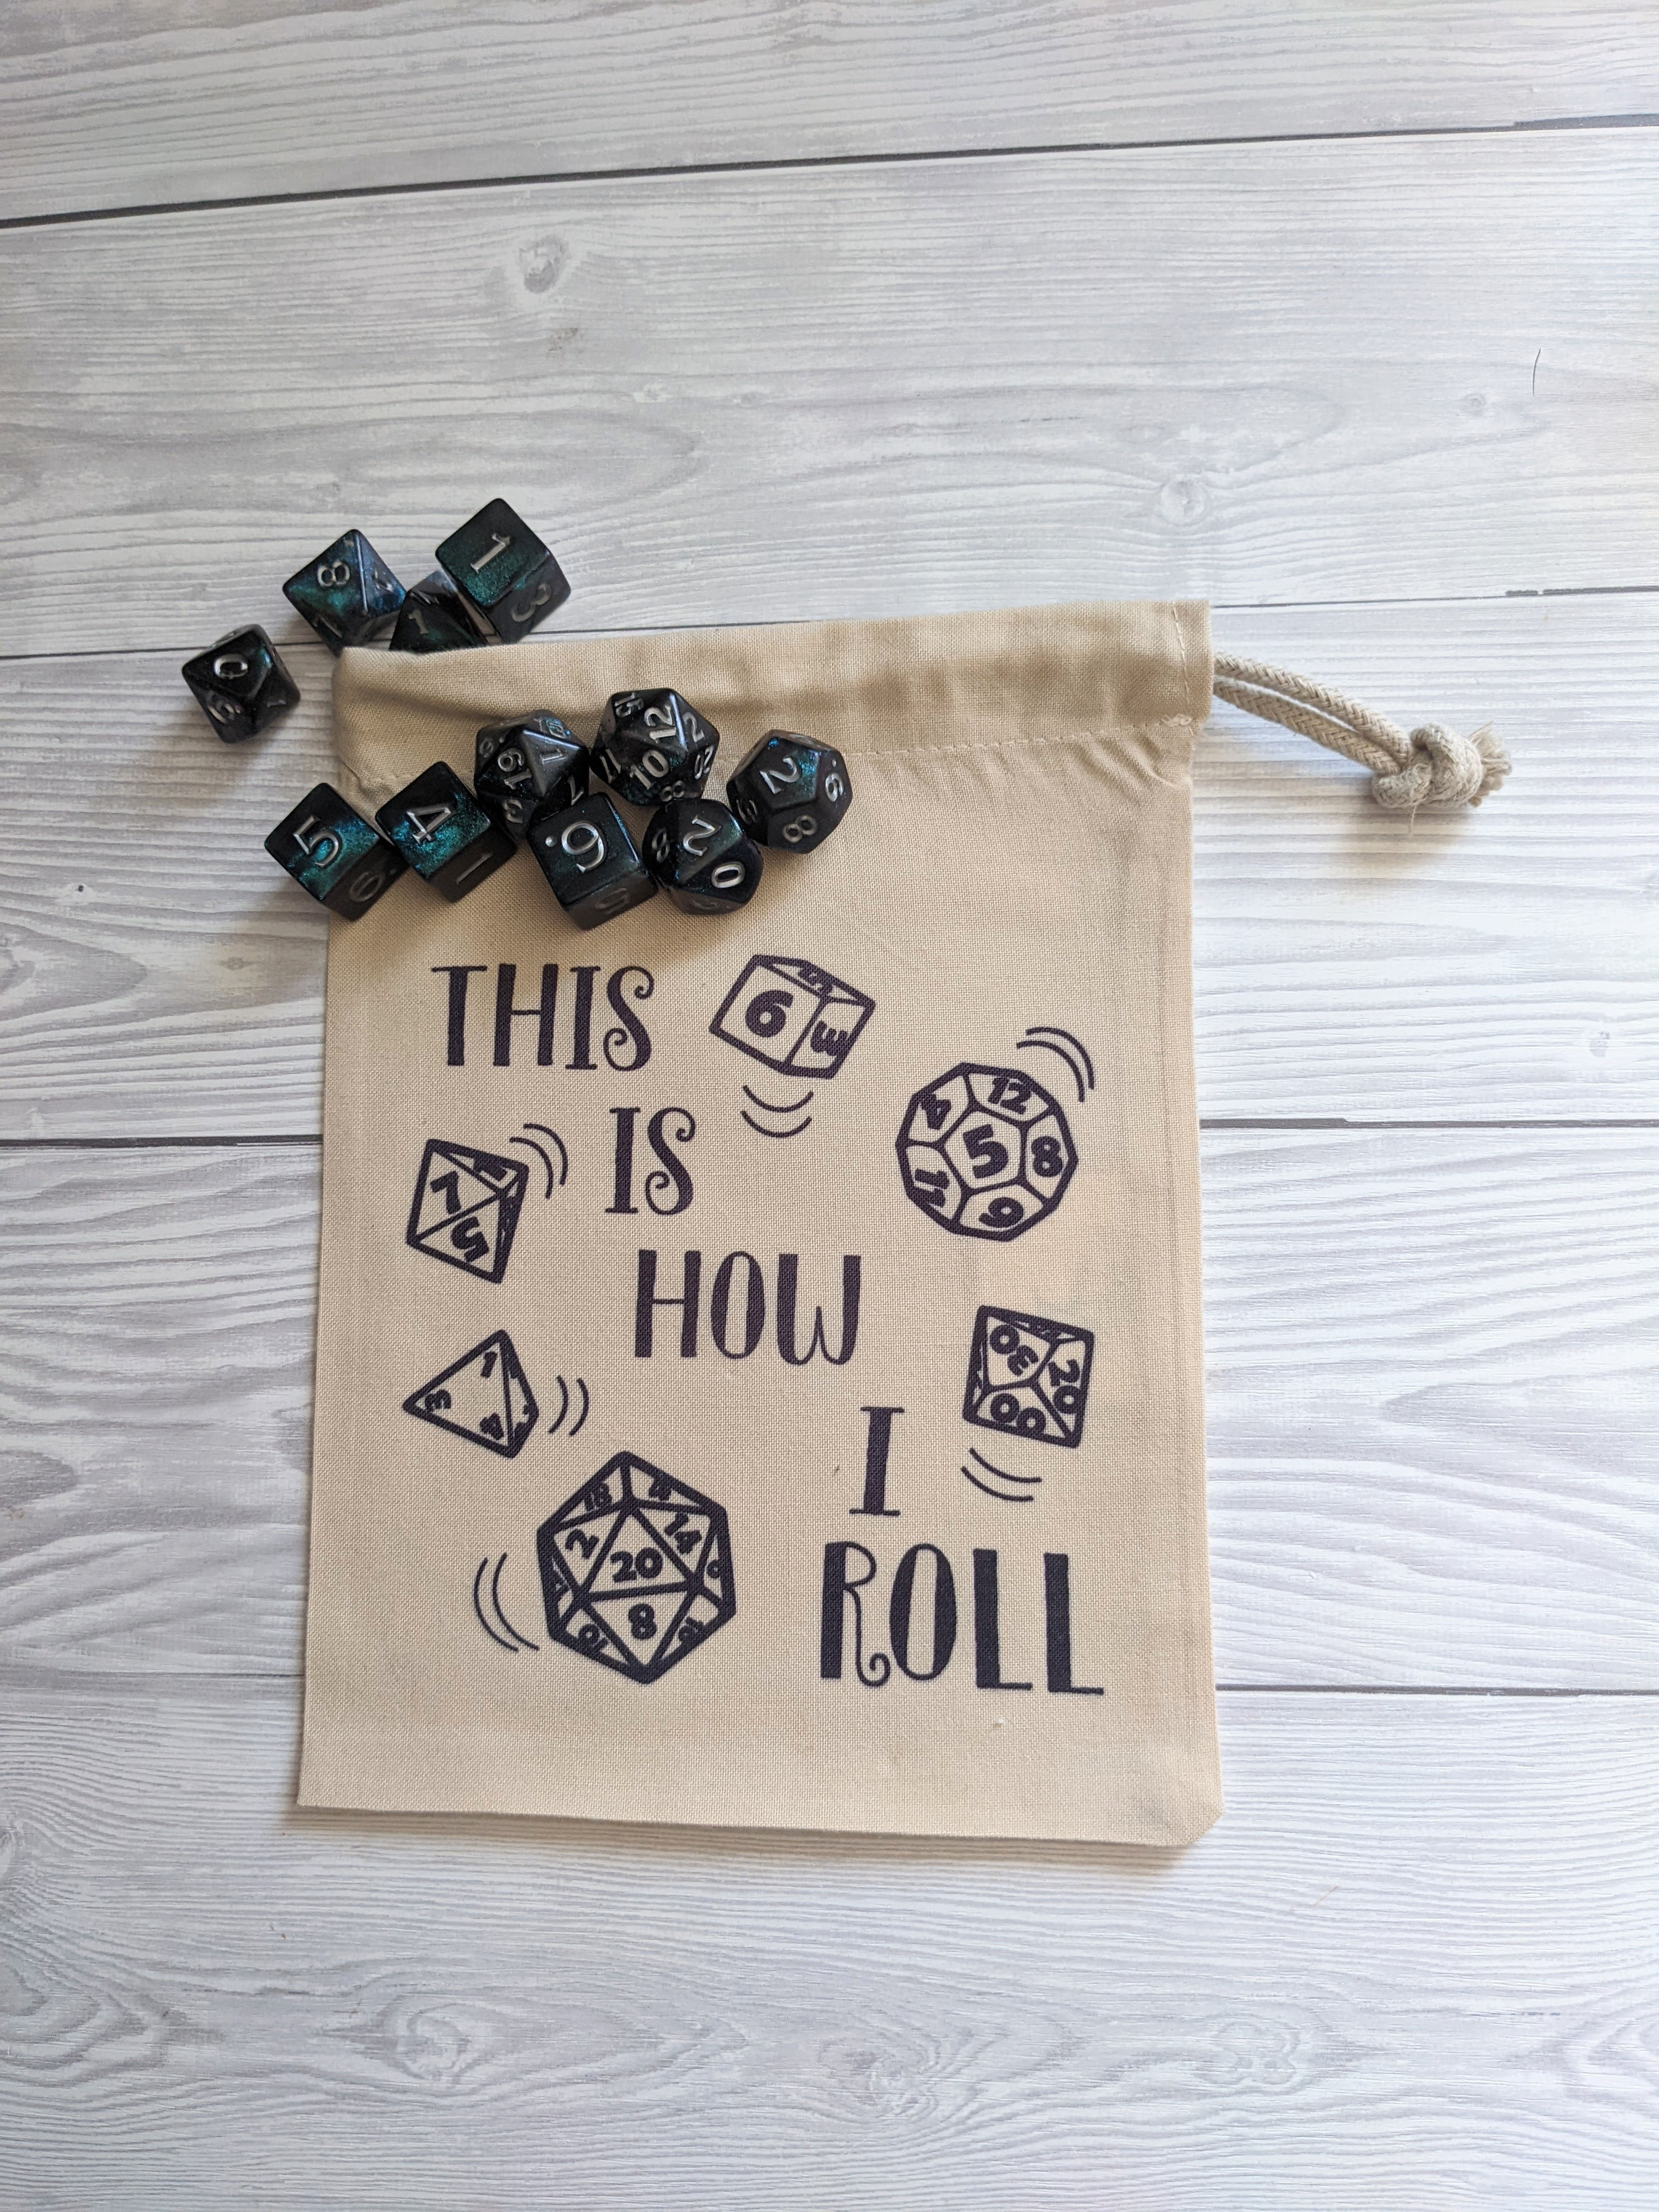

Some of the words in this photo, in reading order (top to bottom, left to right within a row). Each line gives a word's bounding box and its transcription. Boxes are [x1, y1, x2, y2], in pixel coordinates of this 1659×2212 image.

[317, 560, 350, 587] 8
[470, 533, 511, 574] 1
[645, 705, 676, 743] 12
[683, 712, 706, 742] 2
[629, 750, 669, 789] 10
[760, 757, 800, 794] 2
[294, 815, 342, 868] 5
[406, 803, 457, 845] 4
[683, 815, 721, 856] 2
[782, 814, 817, 843] 8
[712, 861, 746, 889] 0
[431, 963, 654, 1071] THIS
[745, 990, 793, 1038] 6
[988, 1077, 1030, 1114] 12
[605, 1107, 696, 1215] IS
[963, 1124, 1009, 1179] 5
[1031, 1136, 1063, 1177] 8
[451, 1216, 489, 1262] 5
[634, 1249, 861, 1365] HOW
[849, 1406, 905, 1516] I
[566, 1528, 599, 1559] 2
[664, 1513, 702, 1554] 14
[610, 1547, 663, 1583] 20
[628, 1603, 657, 1640] 8
[821, 1541, 1104, 1695] ROLL
